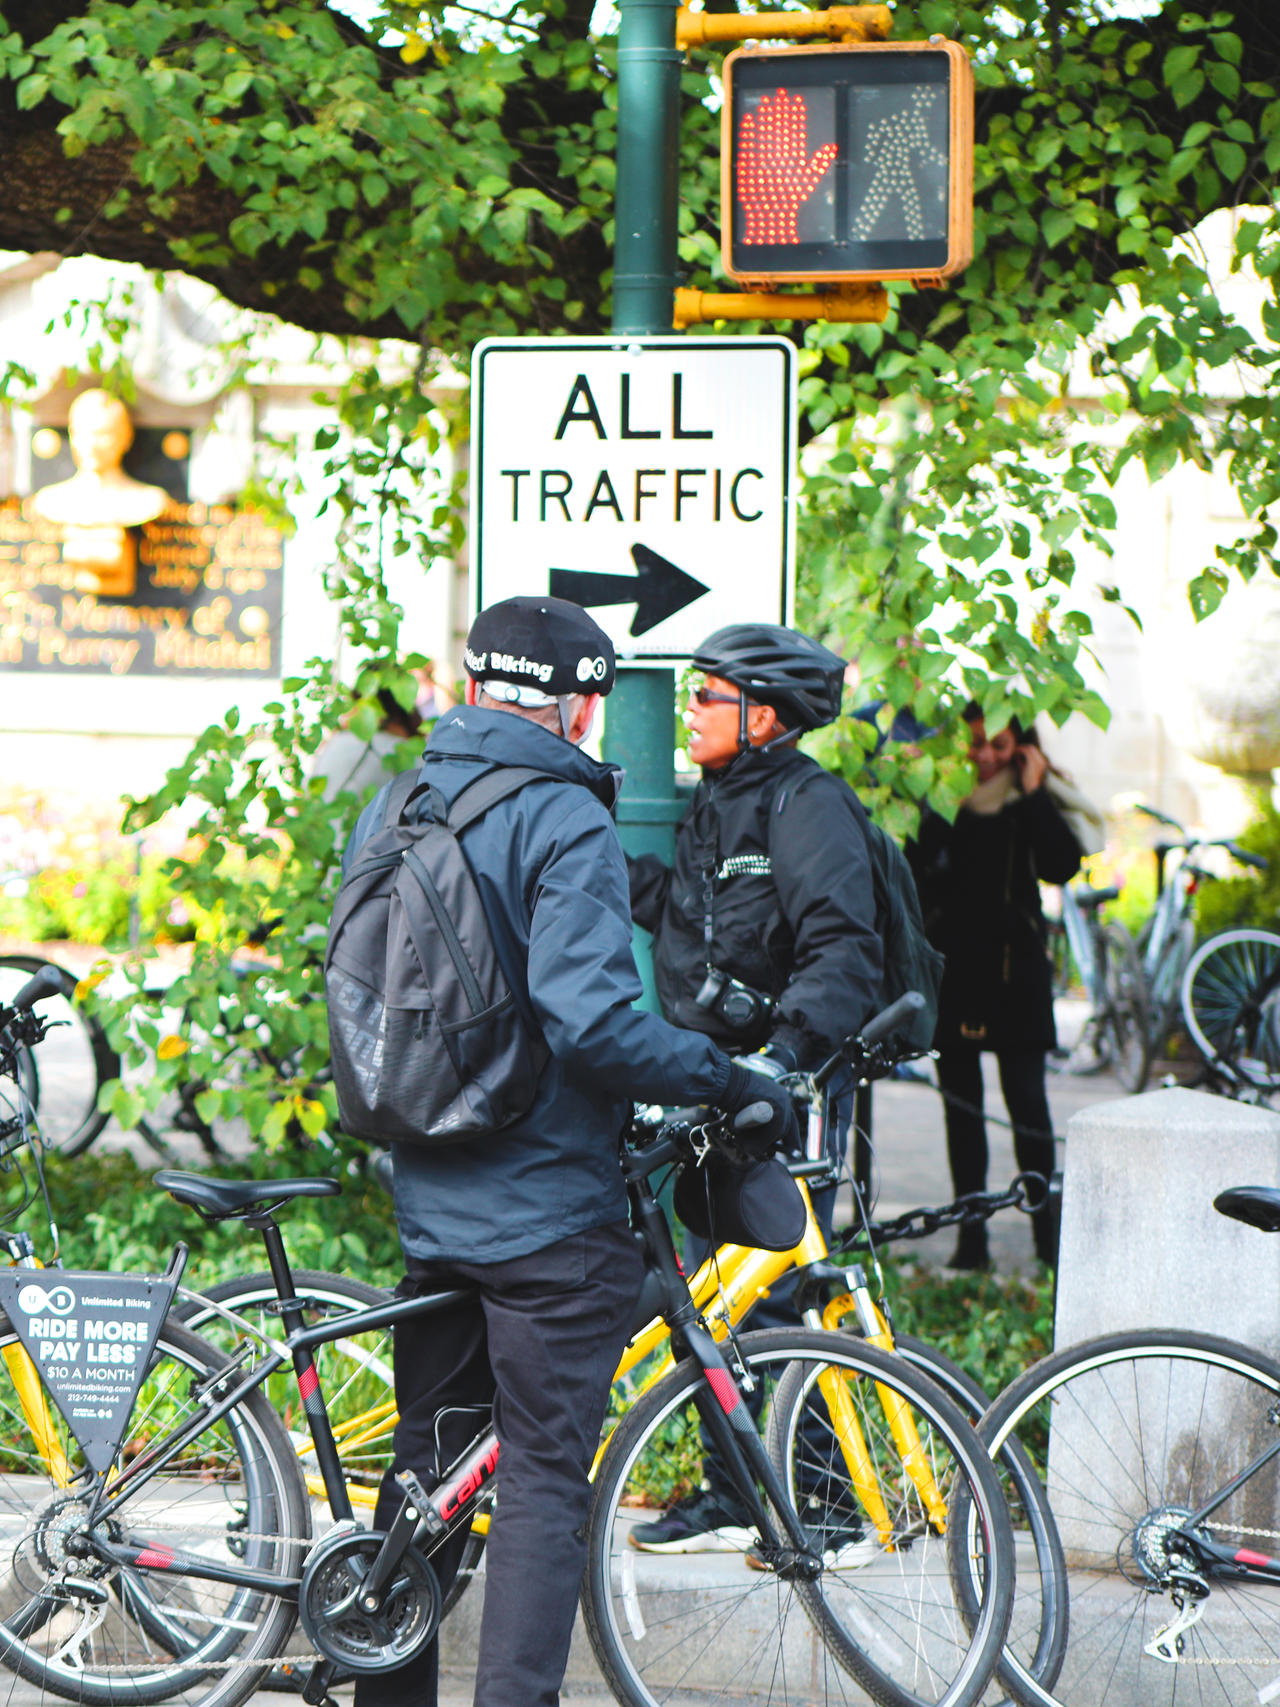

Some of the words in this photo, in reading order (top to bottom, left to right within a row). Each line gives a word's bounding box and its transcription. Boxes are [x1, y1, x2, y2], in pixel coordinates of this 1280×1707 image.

[554, 372, 713, 440] ALL
[500, 468, 764, 522] TRAFFIC
[490, 652, 554, 683] Biking
[81, 1297, 124, 1308] Unlimited
[125, 1298, 151, 1310] Biking
[28, 1317, 78, 1339] RIDE
[84, 1320, 149, 1342] MORE
[39, 1341, 81, 1361] PAY
[87, 1343, 136, 1364] LESS
[47, 1366, 69, 1380] $10
[72, 1368, 82, 1379] A
[85, 1367, 135, 1381] MONTH
[56, 1383, 131, 1393] unlimitedbiking.com
[67, 1394, 120, 1403] 212-749-4444
